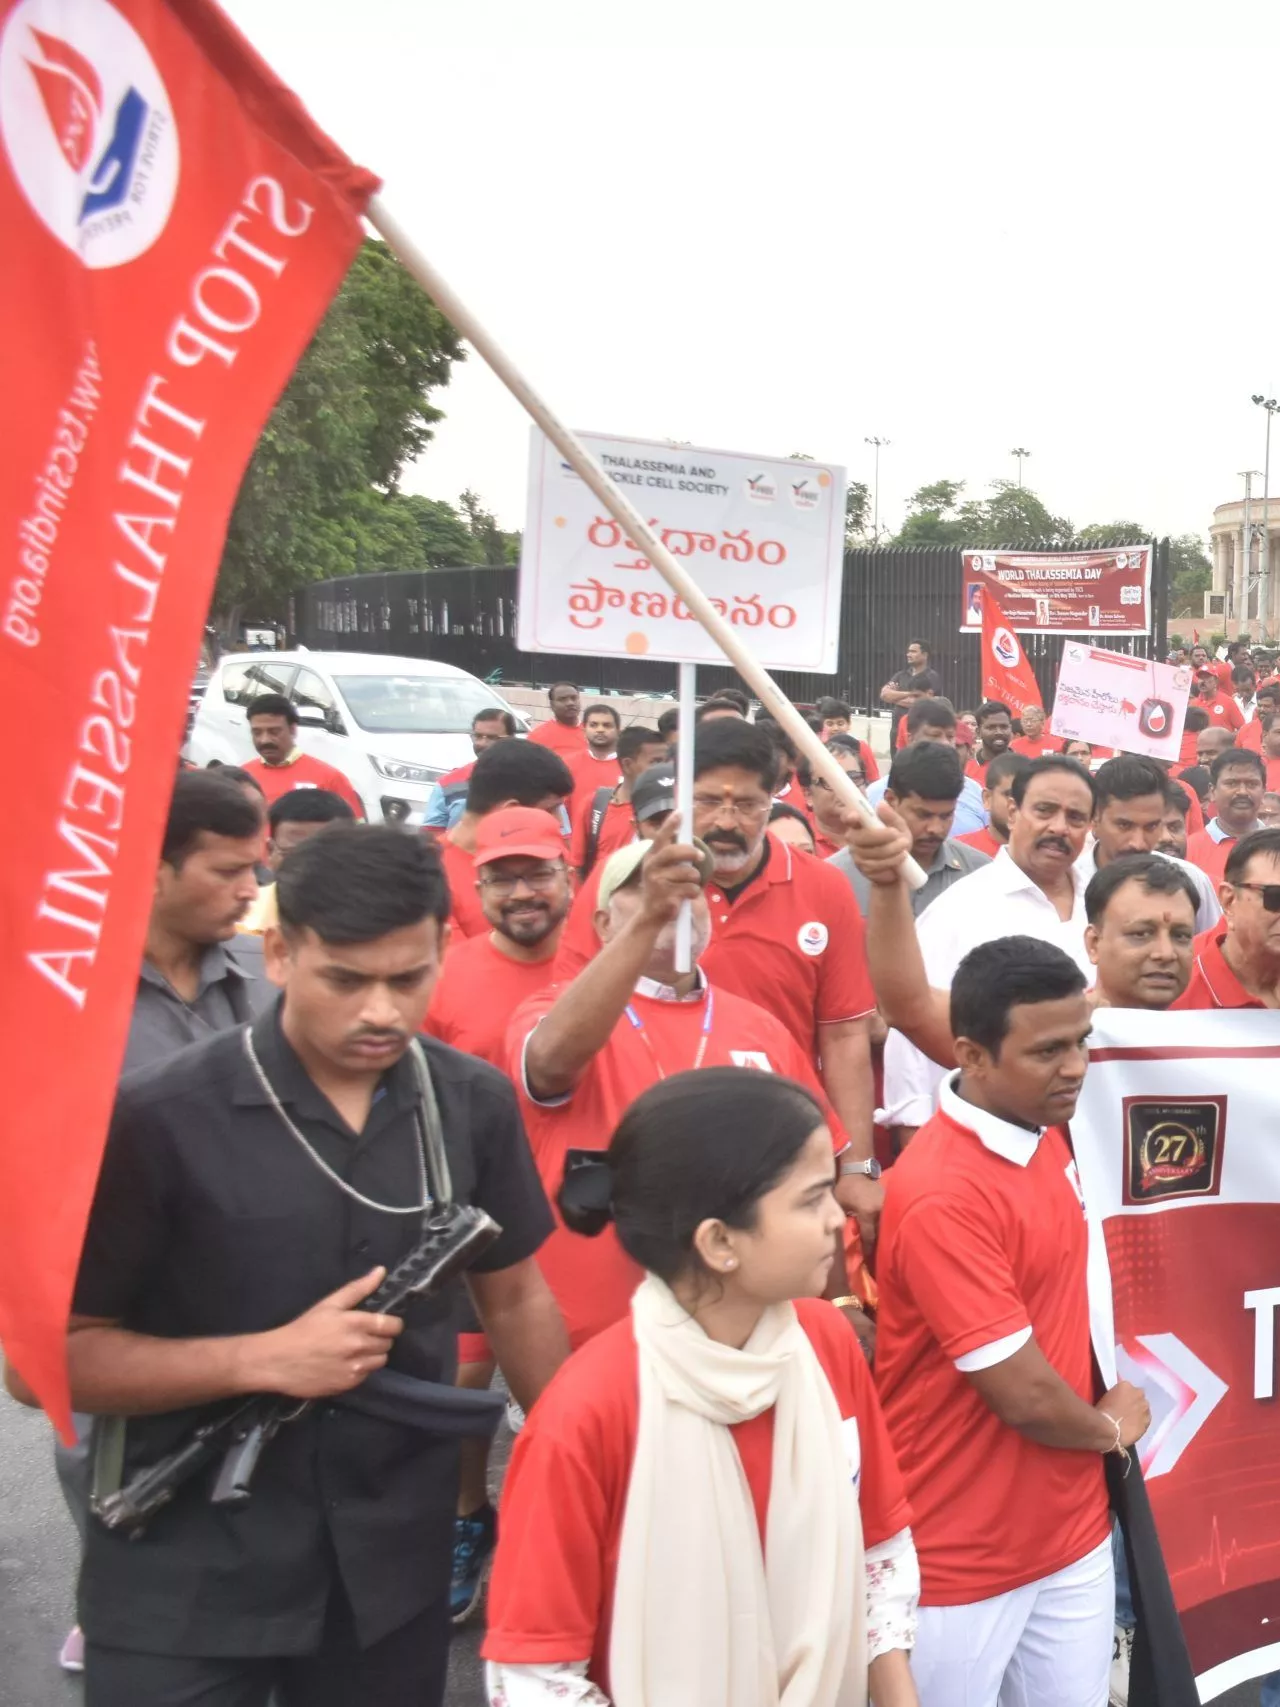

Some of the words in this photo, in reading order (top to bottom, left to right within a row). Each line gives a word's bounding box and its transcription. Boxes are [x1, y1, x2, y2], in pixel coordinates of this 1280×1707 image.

[602, 454, 687, 475] THALASSEMIA
[690, 466, 716, 479] AND
[605, 470, 642, 486] ICKLE
[646, 476, 674, 490] CELL
[678, 480, 730, 496] SOCIETY
[998, 570, 1024, 581] WORLD
[1026, 568, 1082, 580] THALASSEMIA
[1084, 567, 1102, 580] DAY
[1154, 1135, 1188, 1164] 27
